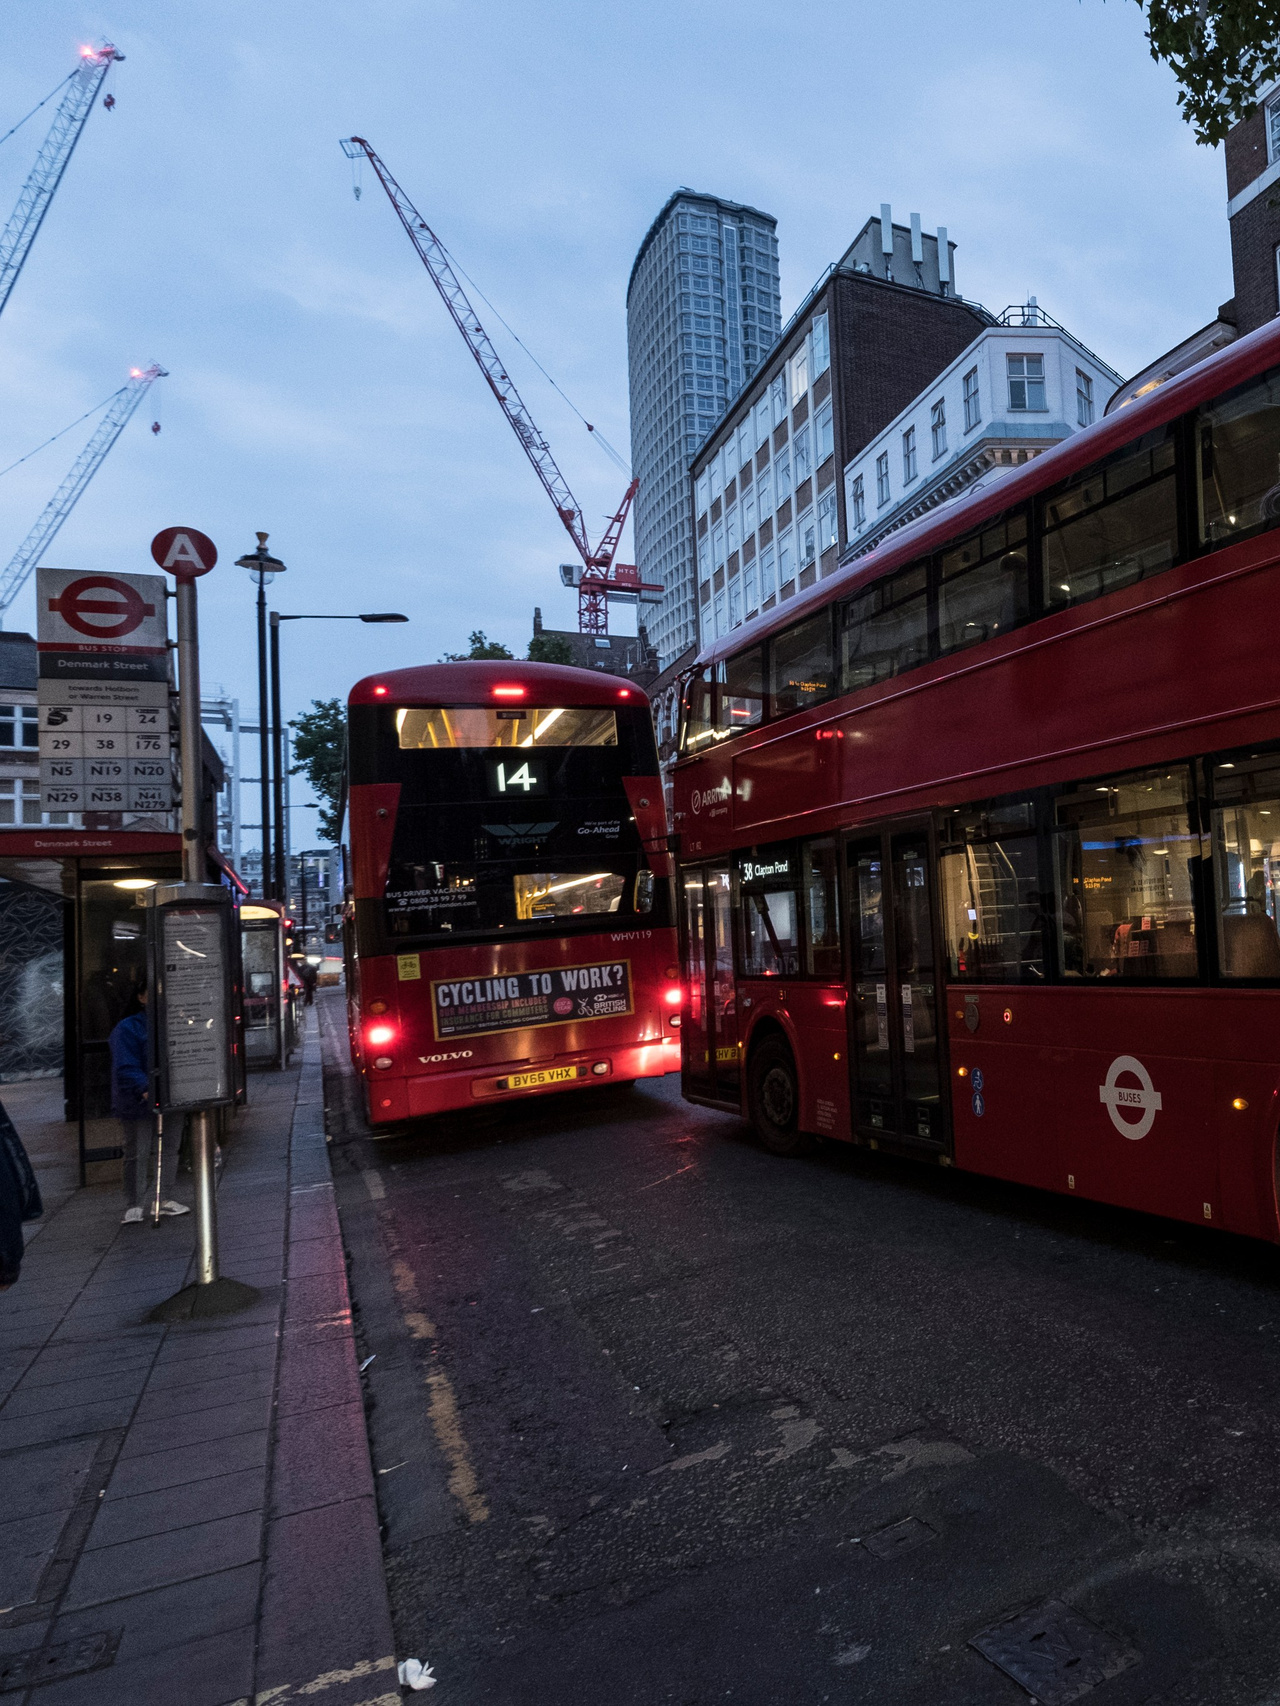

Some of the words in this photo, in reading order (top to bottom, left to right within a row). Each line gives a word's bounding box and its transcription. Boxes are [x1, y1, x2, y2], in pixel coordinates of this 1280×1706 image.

[163, 533, 206, 569] A
[58, 659, 110, 669] Denmark
[114, 661, 149, 671] Street
[96, 713, 113, 723] 19
[138, 714, 157, 724] 24
[52, 739, 70, 749] 29
[96, 739, 115, 749] 38
[136, 740, 161, 750] 176
[51, 766, 73, 776] N5
[91, 766, 121, 776] N19
[134, 766, 164, 776] N20
[497, 762, 537, 792] 14
[47, 792, 78, 802] N29
[91, 792, 122, 802] N38
[138, 791, 161, 800] N41
[134, 800, 166, 809] N279
[577, 826, 620, 835] Go-Ahead
[34, 840, 80, 848] Denmark
[82, 839, 113, 847] Street
[498, 836, 549, 845] WRIGHT
[743, 862, 753, 881] 38
[754, 864, 774, 878] Clapton
[774, 860, 789, 874] Pond
[386, 891, 402, 899] BUS
[403, 889, 431, 897] DRIVER
[433, 885, 476, 895] VACANCIES
[388, 900, 477, 913] www.go-ahead-london.com
[610, 930, 652, 942] WHV119
[437, 977, 519, 1007] CYCLING
[529, 973, 552, 996] TO
[560, 965, 623, 992] WORK?
[440, 1007, 455, 1017] OUR
[457, 1001, 509, 1015] MEMBERSHIP
[511, 996, 547, 1008] INCLUDES
[593, 999, 626, 1009] BRITISH
[594, 1005, 626, 1015] CYCLING
[441, 1012, 483, 1026] INSURANCE
[486, 1010, 500, 1020] FOR
[502, 1005, 549, 1018] COMMUTERS
[418, 1050, 473, 1064] VOLVO
[514, 1072, 545, 1087] BV66
[550, 1068, 572, 1081] VHX
[1118, 1091, 1142, 1104] BUSES
